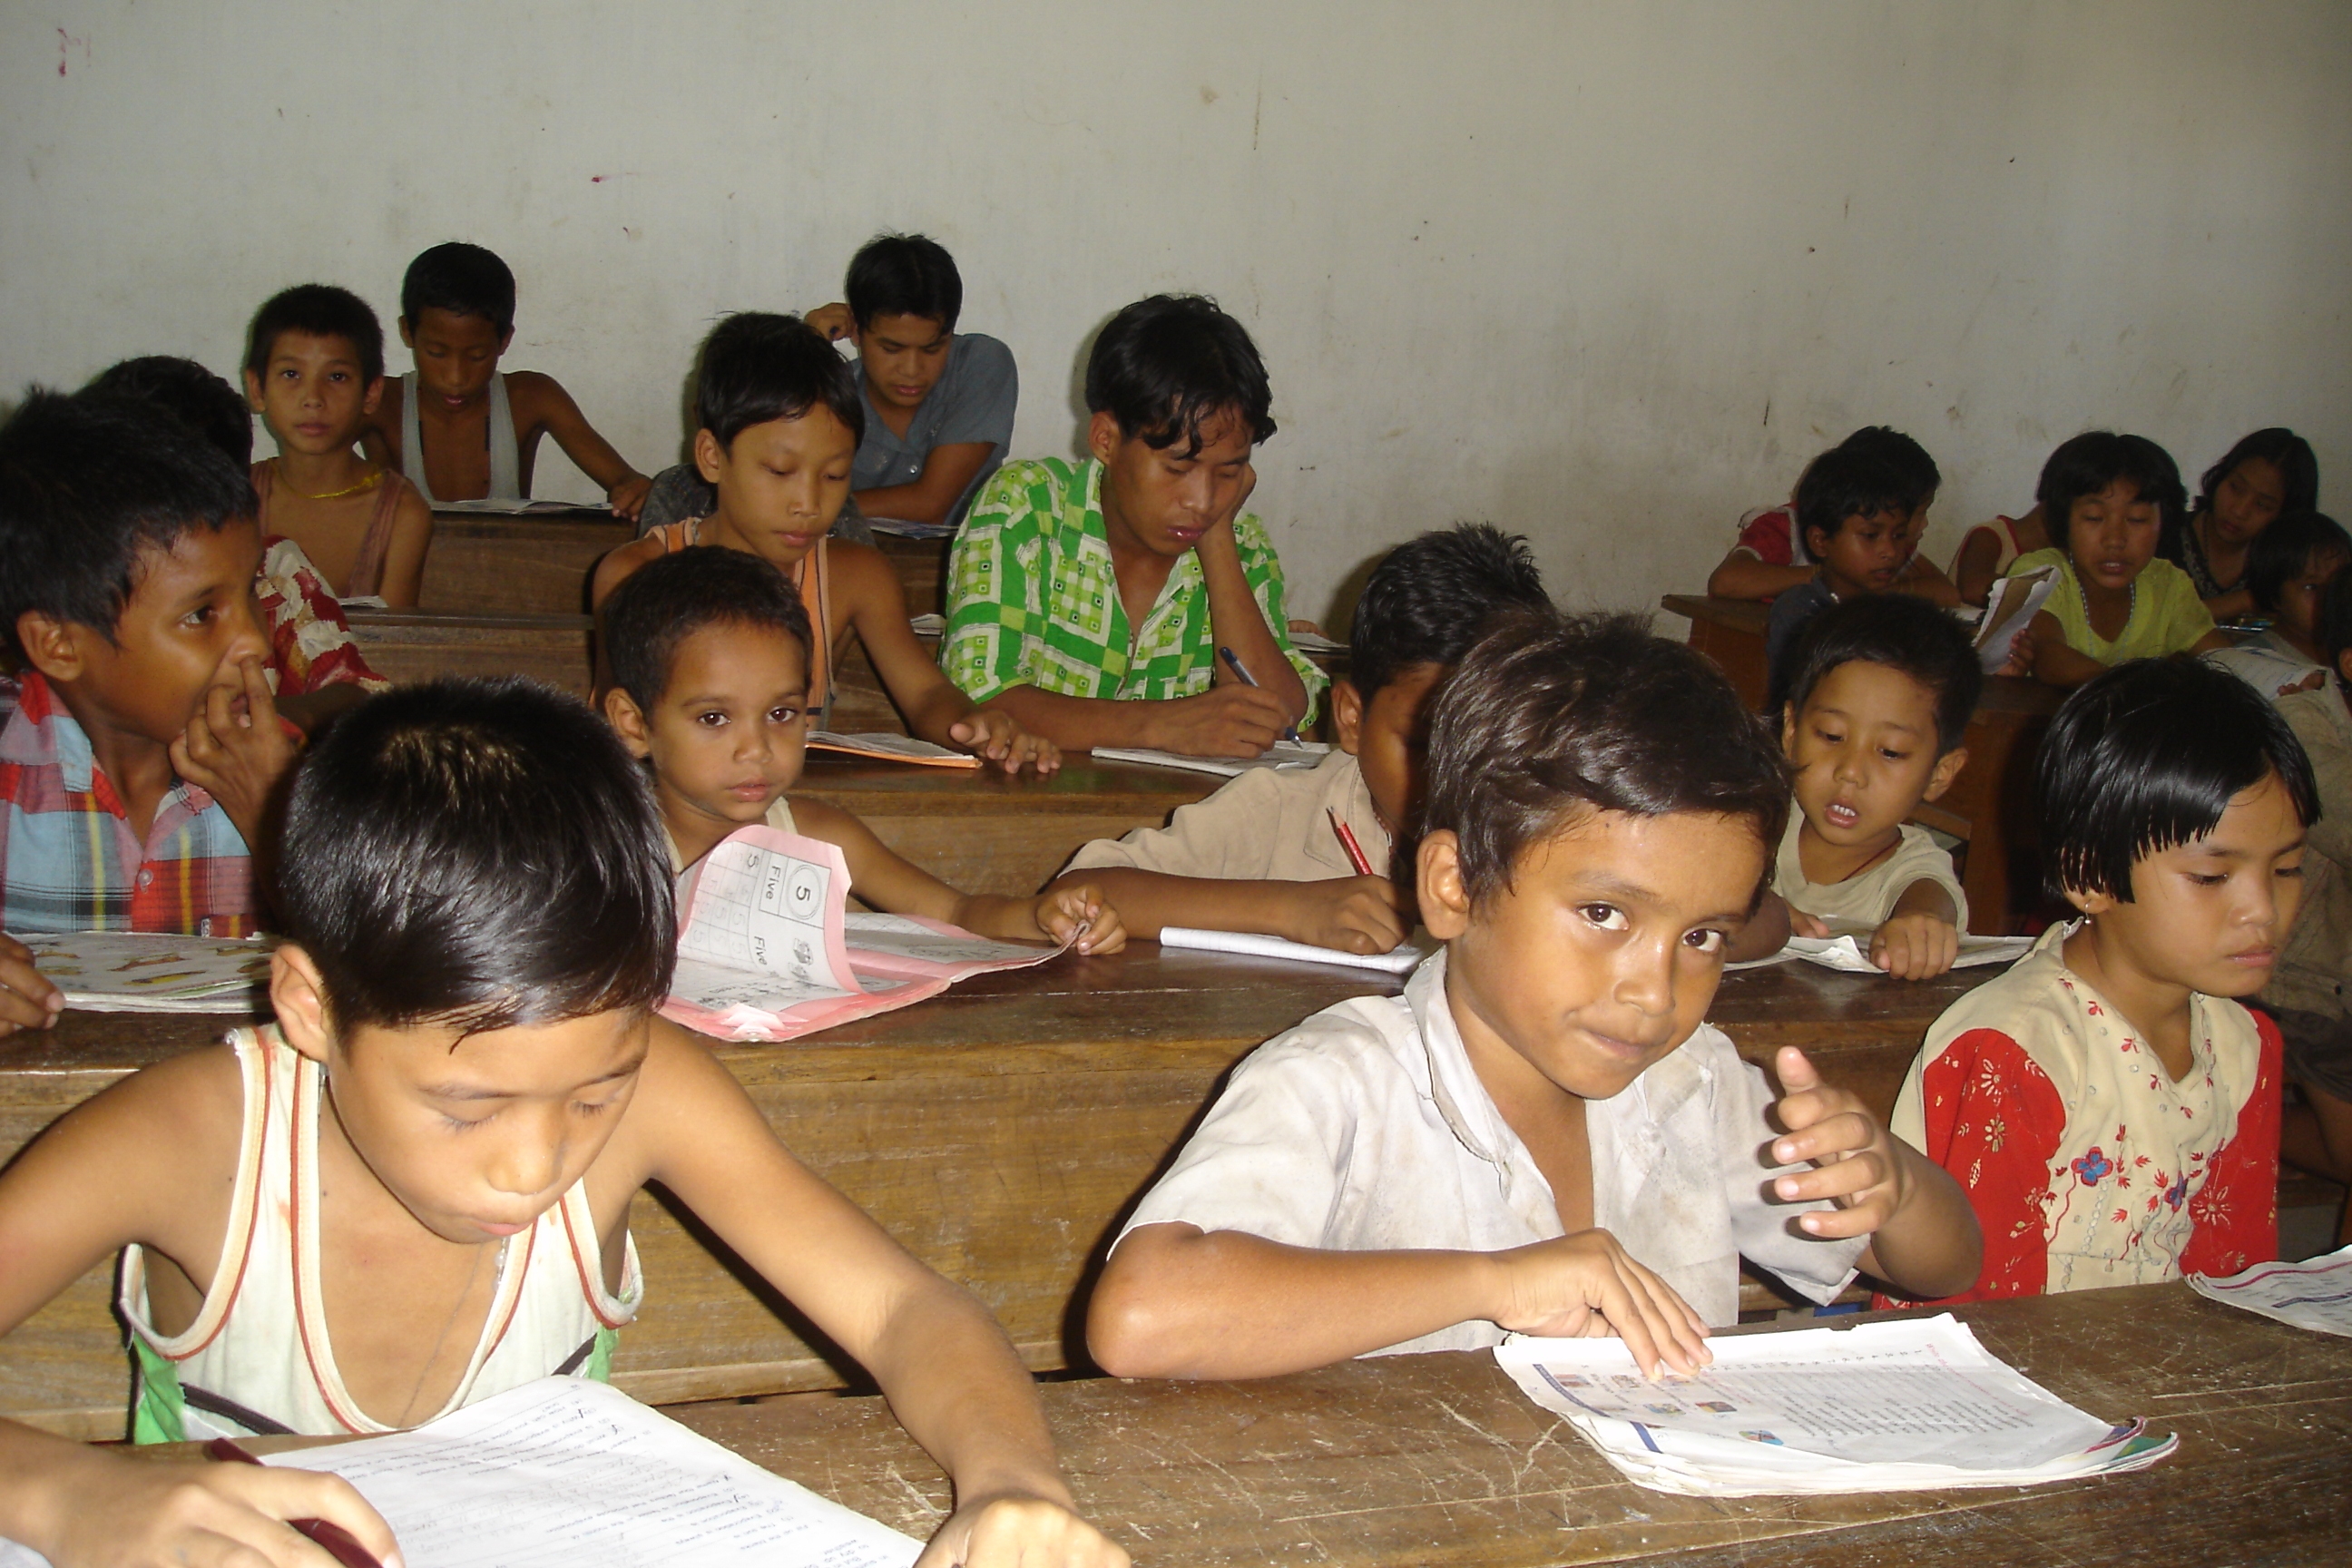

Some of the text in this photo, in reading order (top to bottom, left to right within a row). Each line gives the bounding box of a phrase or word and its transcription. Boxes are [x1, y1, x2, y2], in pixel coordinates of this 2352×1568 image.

[765, 866, 780, 900] Five
[795, 886, 812, 902] 5
[753, 936, 768, 965] Five
